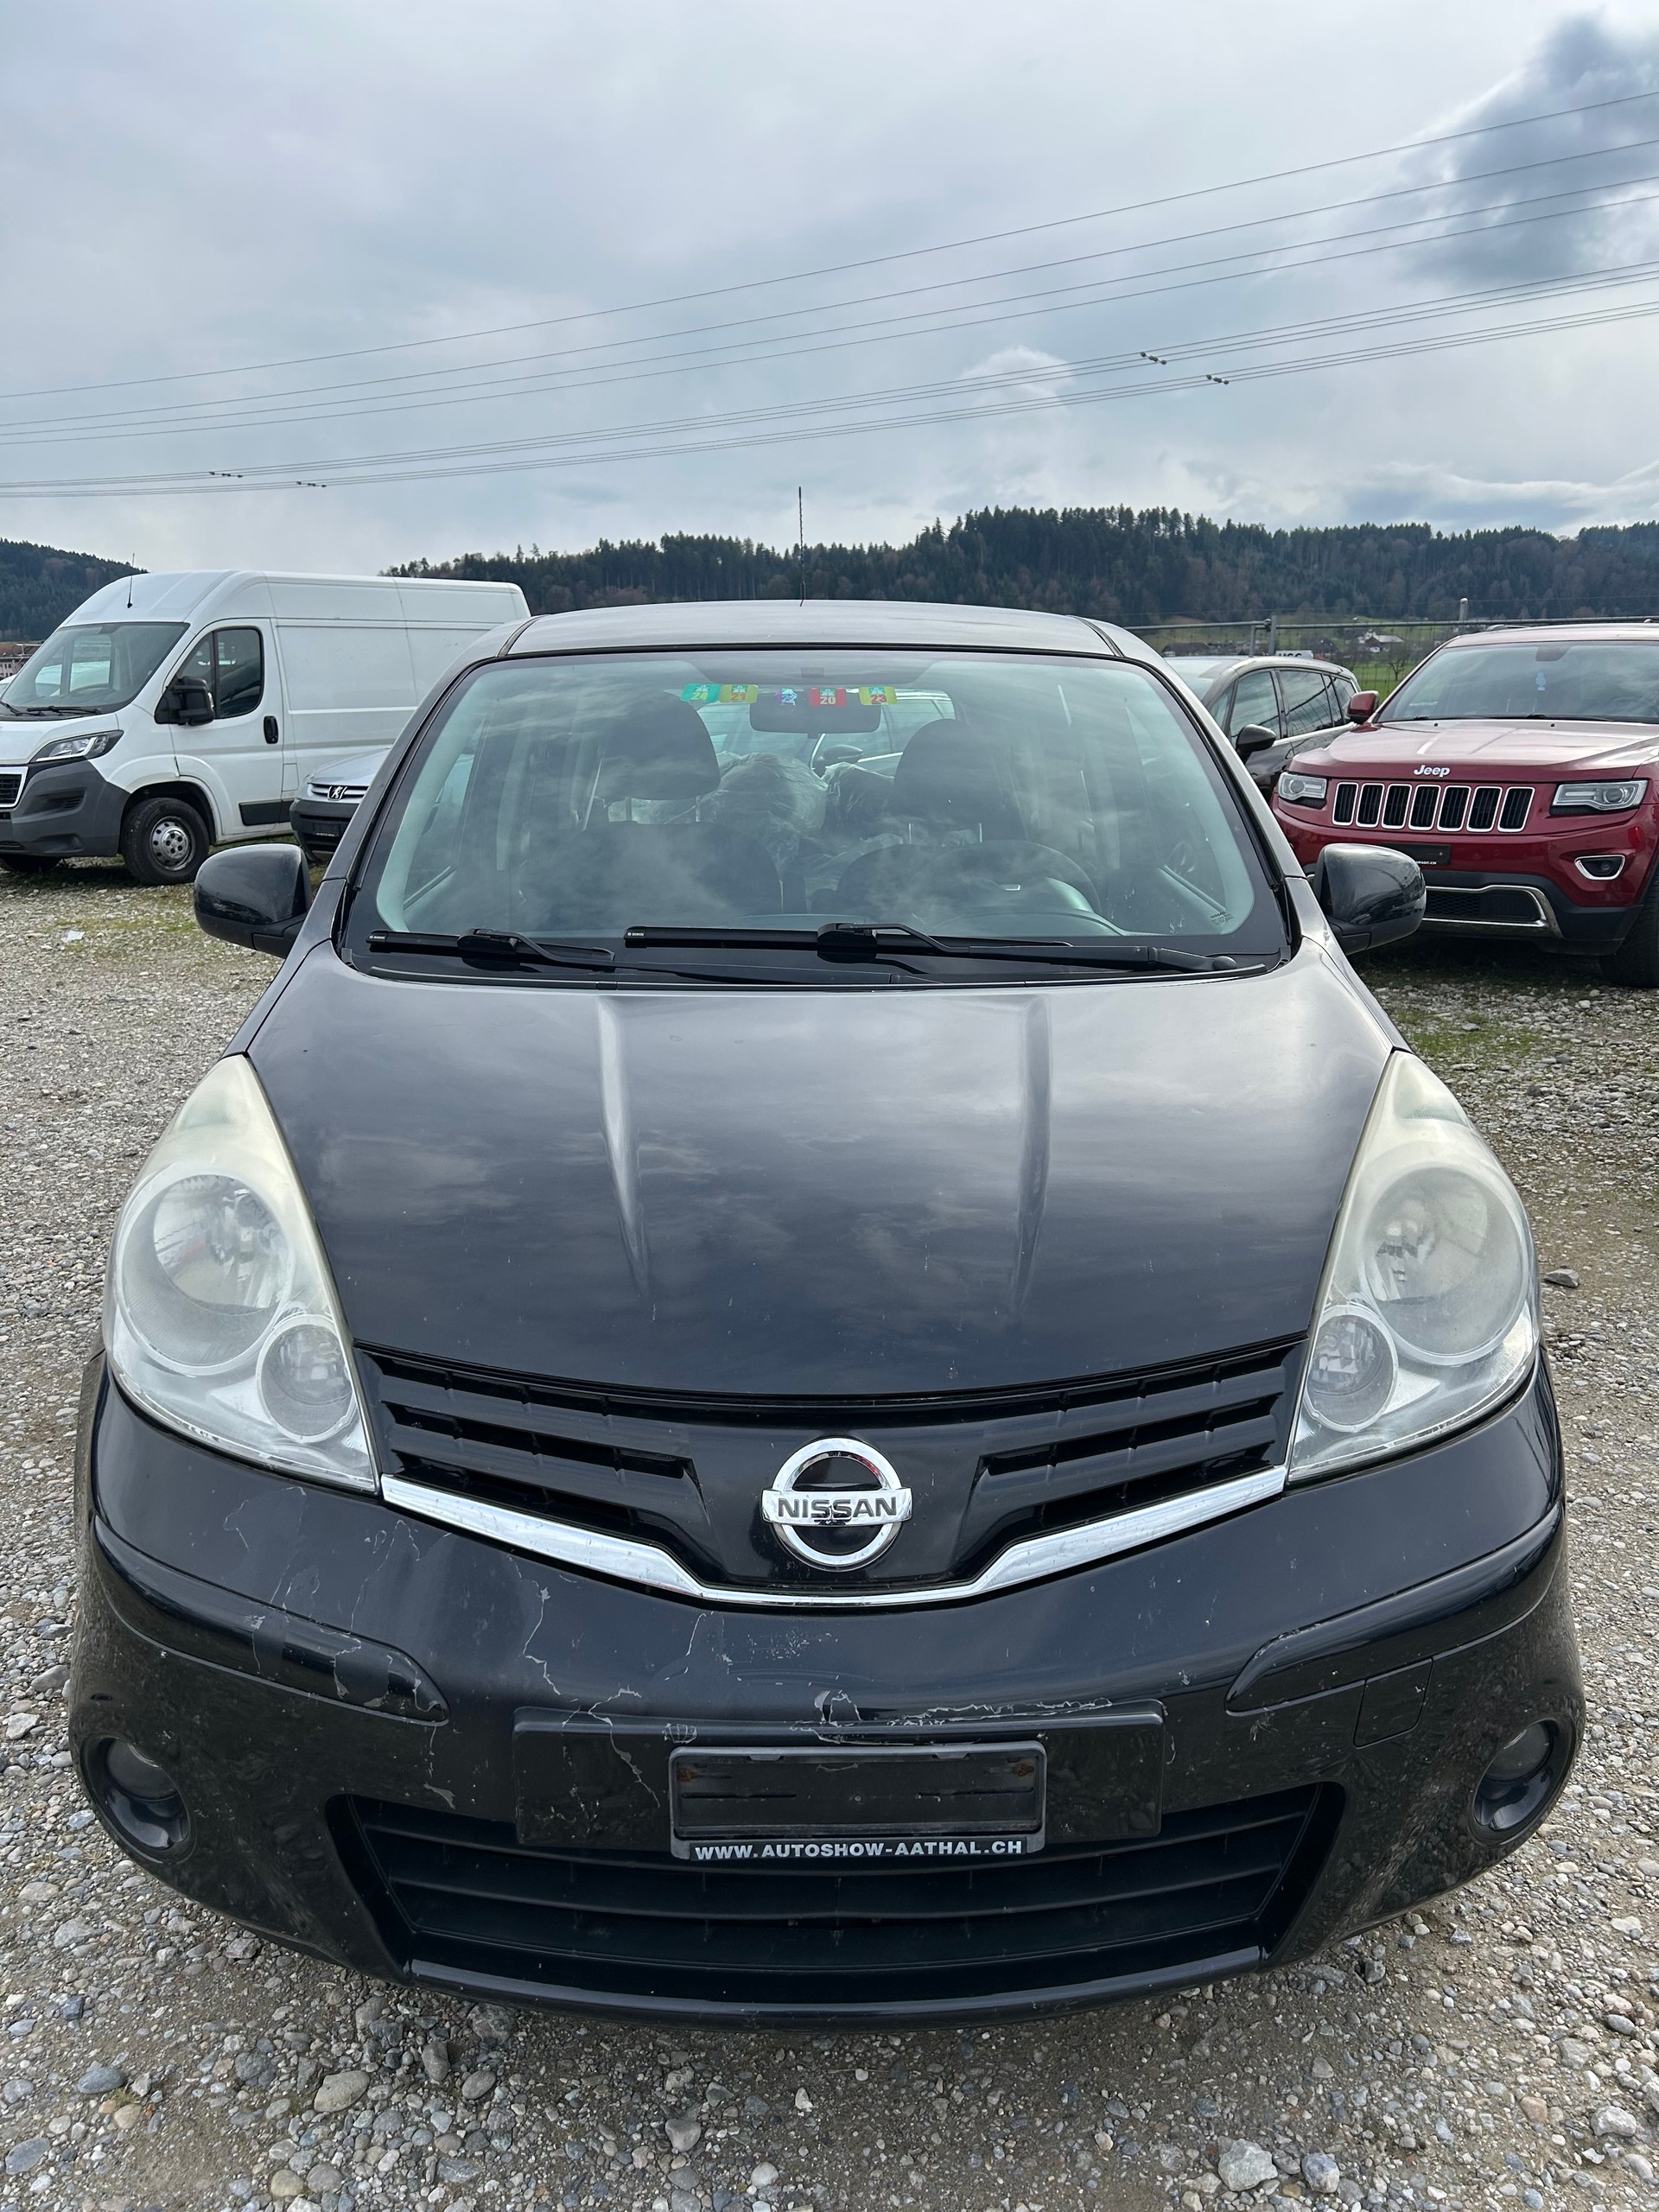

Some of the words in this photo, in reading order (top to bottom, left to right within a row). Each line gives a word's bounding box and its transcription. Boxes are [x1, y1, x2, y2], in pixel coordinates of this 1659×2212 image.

[691, 691, 709, 701] 24
[730, 692, 747, 702] 21
[820, 696, 836, 705] 20
[871, 694, 887, 704] 23
[1414, 765, 1451, 778] Jeep
[778, 1497, 897, 1520] NISSAN
[695, 1840, 1022, 1860] WWW.AUTOSHOW-AATHAL.CH
